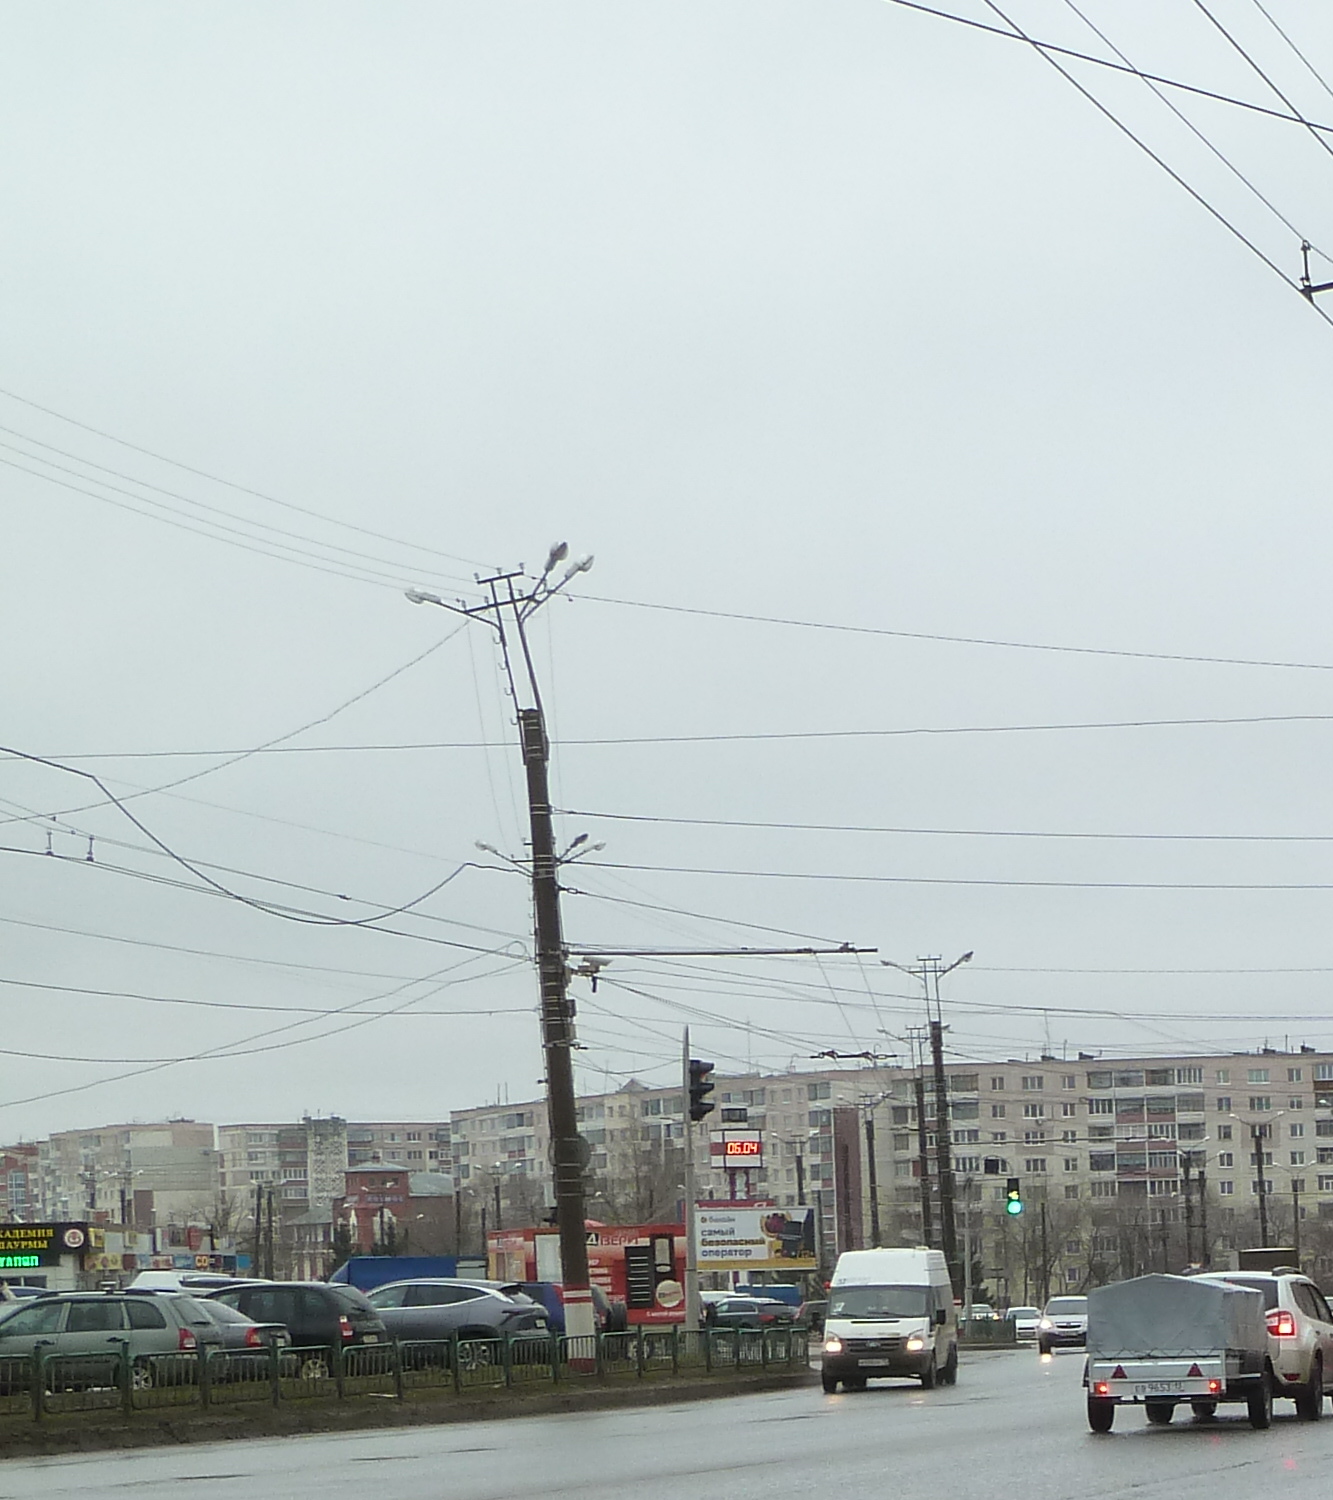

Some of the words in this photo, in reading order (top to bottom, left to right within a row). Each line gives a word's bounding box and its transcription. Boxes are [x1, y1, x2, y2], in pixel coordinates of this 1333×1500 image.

[727, 1142, 758, 1155] 06.04
[701, 1228, 735, 1237] самый
[701, 1249, 752, 1259] оператор
